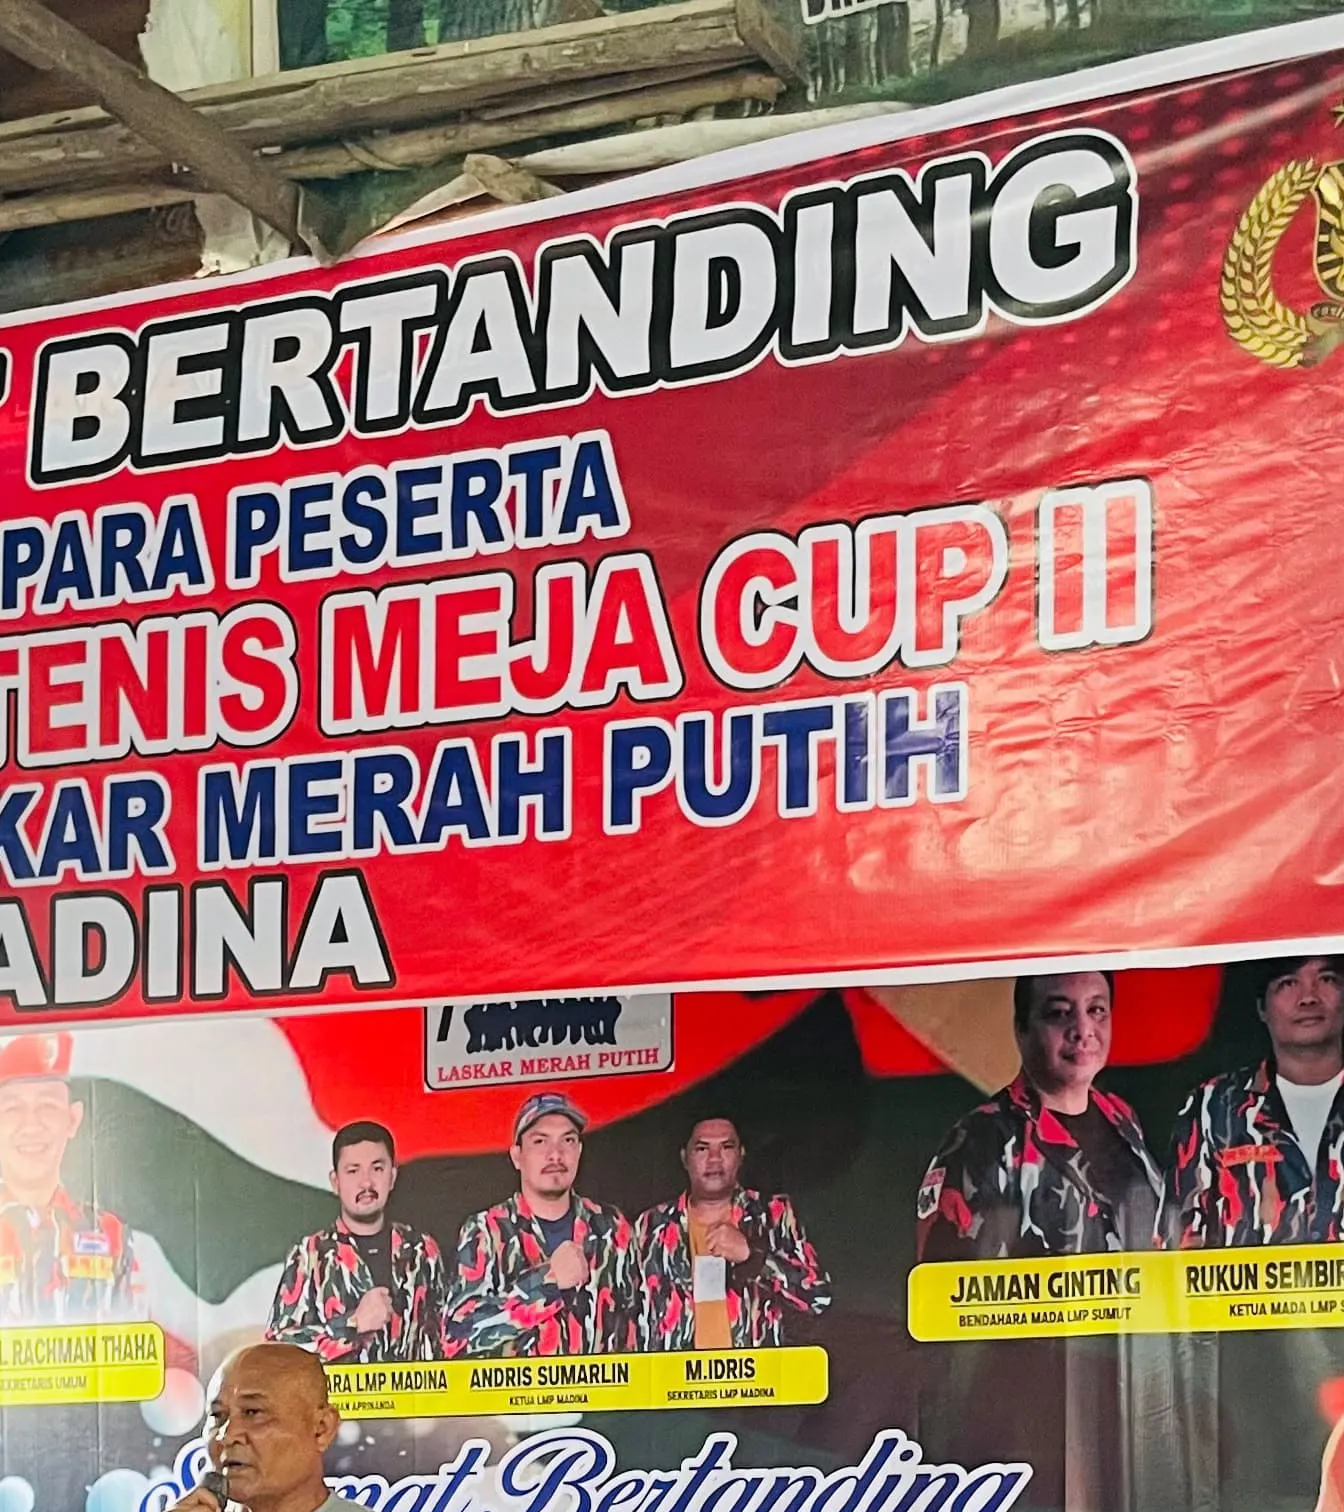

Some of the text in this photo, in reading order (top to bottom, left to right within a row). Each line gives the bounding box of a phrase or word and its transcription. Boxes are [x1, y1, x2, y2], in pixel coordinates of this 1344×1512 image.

[33, 136, 1134, 482] BERTANDING
[1, 503, 205, 611] PARA
[234, 438, 624, 578] PESERTA
[325, 562, 676, 730] MEJA
[706, 514, 1006, 684] CUP
[1040, 486, 1150, 644] II
[202, 731, 567, 864] MERAH
[609, 688, 964, 832] PUTIH
[437, 1047, 659, 1082] LASKAR MERAH PUTIH
[950, 1273, 1041, 1304] JAMAN
[1047, 1266, 1141, 1300] GINTING
[1185, 1261, 1258, 1294] RUKUN
[958, 1306, 1132, 1328] BENDAHARA MADA LMP SUMUT
[1229, 1303, 1268, 1318] KETUA
[1269, 1302, 1307, 1317] MADA
[1309, 1300, 1338, 1315] LMP
[12, 1335, 97, 1365] RACHMAN
[101, 1333, 158, 1362] THAHA
[54, 1375, 88, 1390] UMUM
[355, 1372, 387, 1392] LMP
[391, 1369, 448, 1391] MADINA
[469, 1366, 534, 1389] ANDRIS
[537, 1361, 629, 1387] SUMARLIN
[684, 1357, 756, 1382] M.IDRIS
[666, 1388, 717, 1401] SEKRETARIS
[740, 1386, 775, 1399] MADINA
